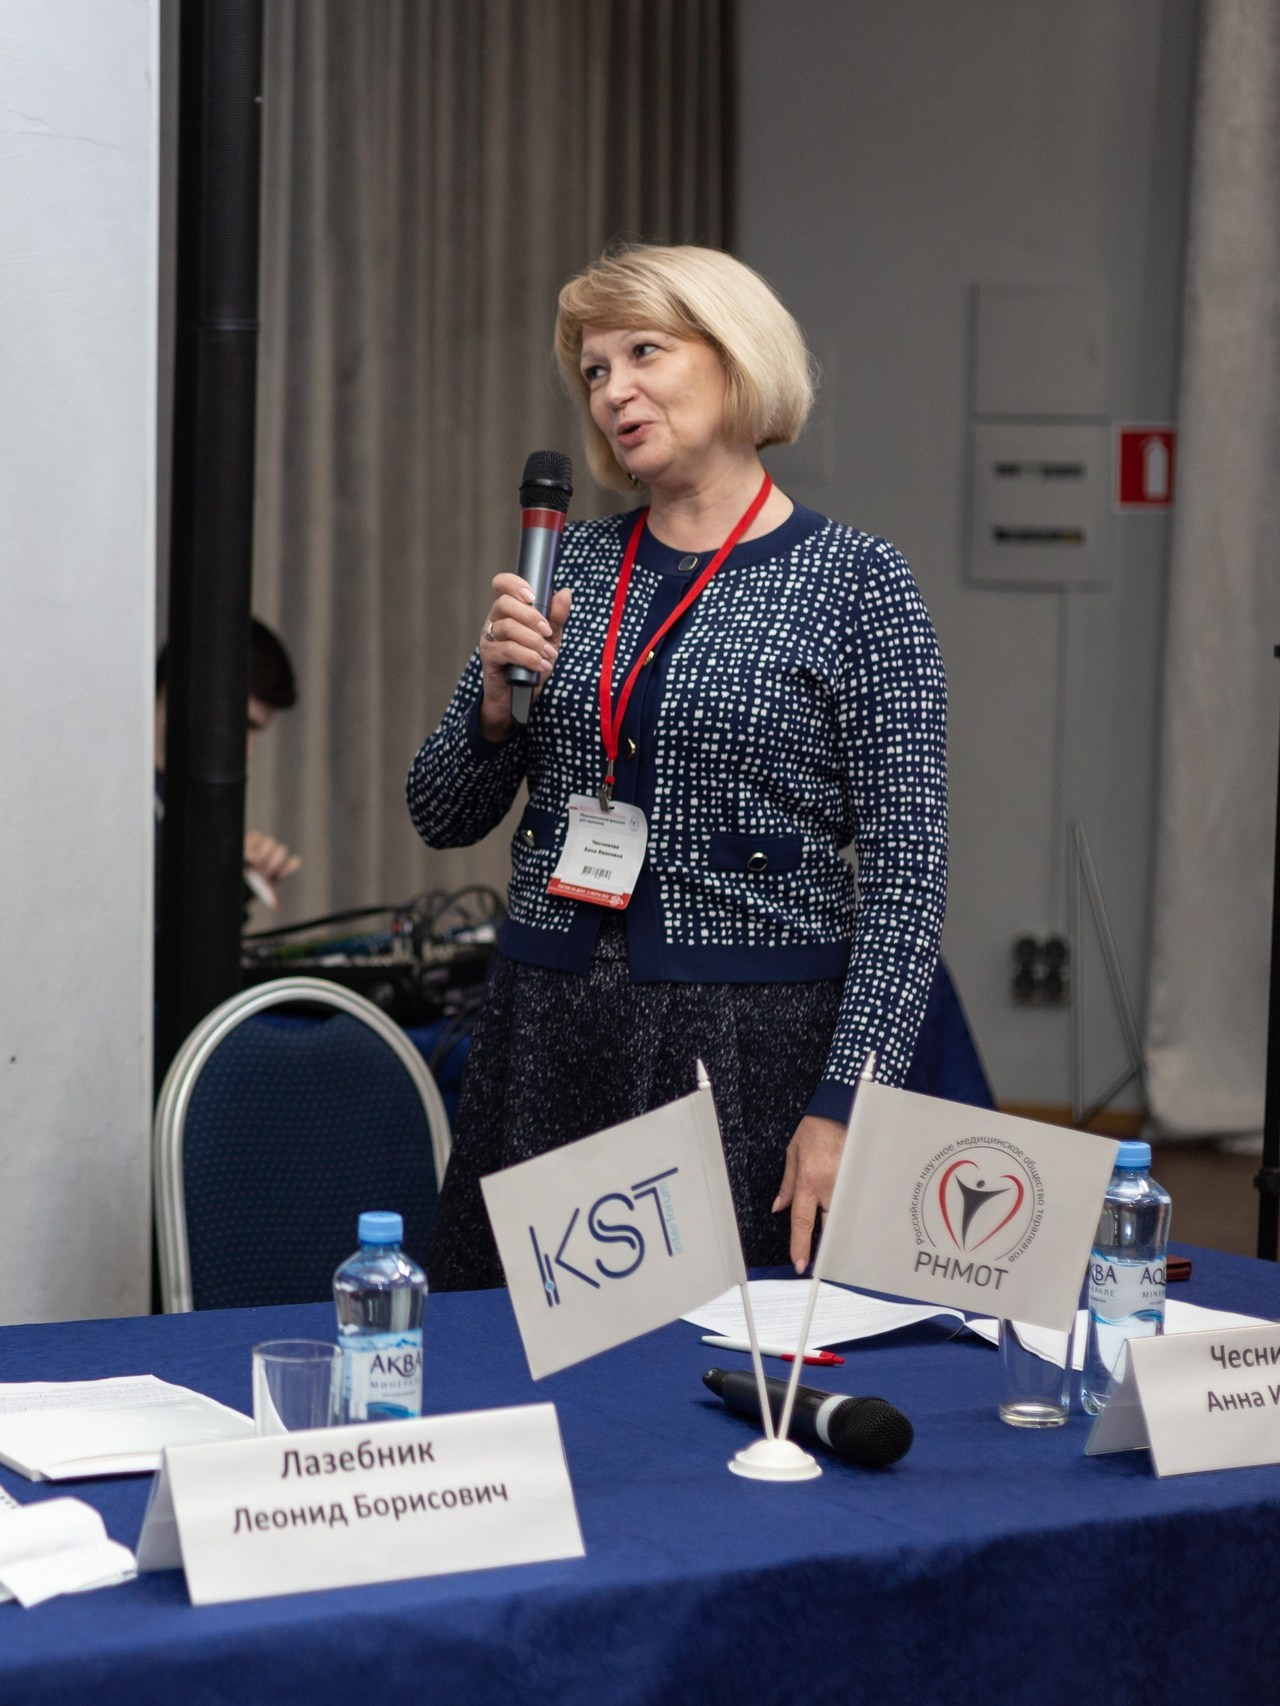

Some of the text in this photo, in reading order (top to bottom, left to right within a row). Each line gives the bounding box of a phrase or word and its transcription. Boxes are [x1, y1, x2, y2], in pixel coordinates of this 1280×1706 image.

[920, 1143, 955, 1180] научное
[956, 1136, 1025, 1158] медицинское
[1023, 1156, 1045, 1206] общество
[528, 1166, 679, 1308] KST
[1008, 1208, 1045, 1263] терапевтов
[914, 1250, 1009, 1290] РНМОТ
[1207, 1391, 1266, 1413] Анна
[280, 1440, 436, 1480] Лазебник
[233, 1482, 509, 1534] Леонид Борисович
